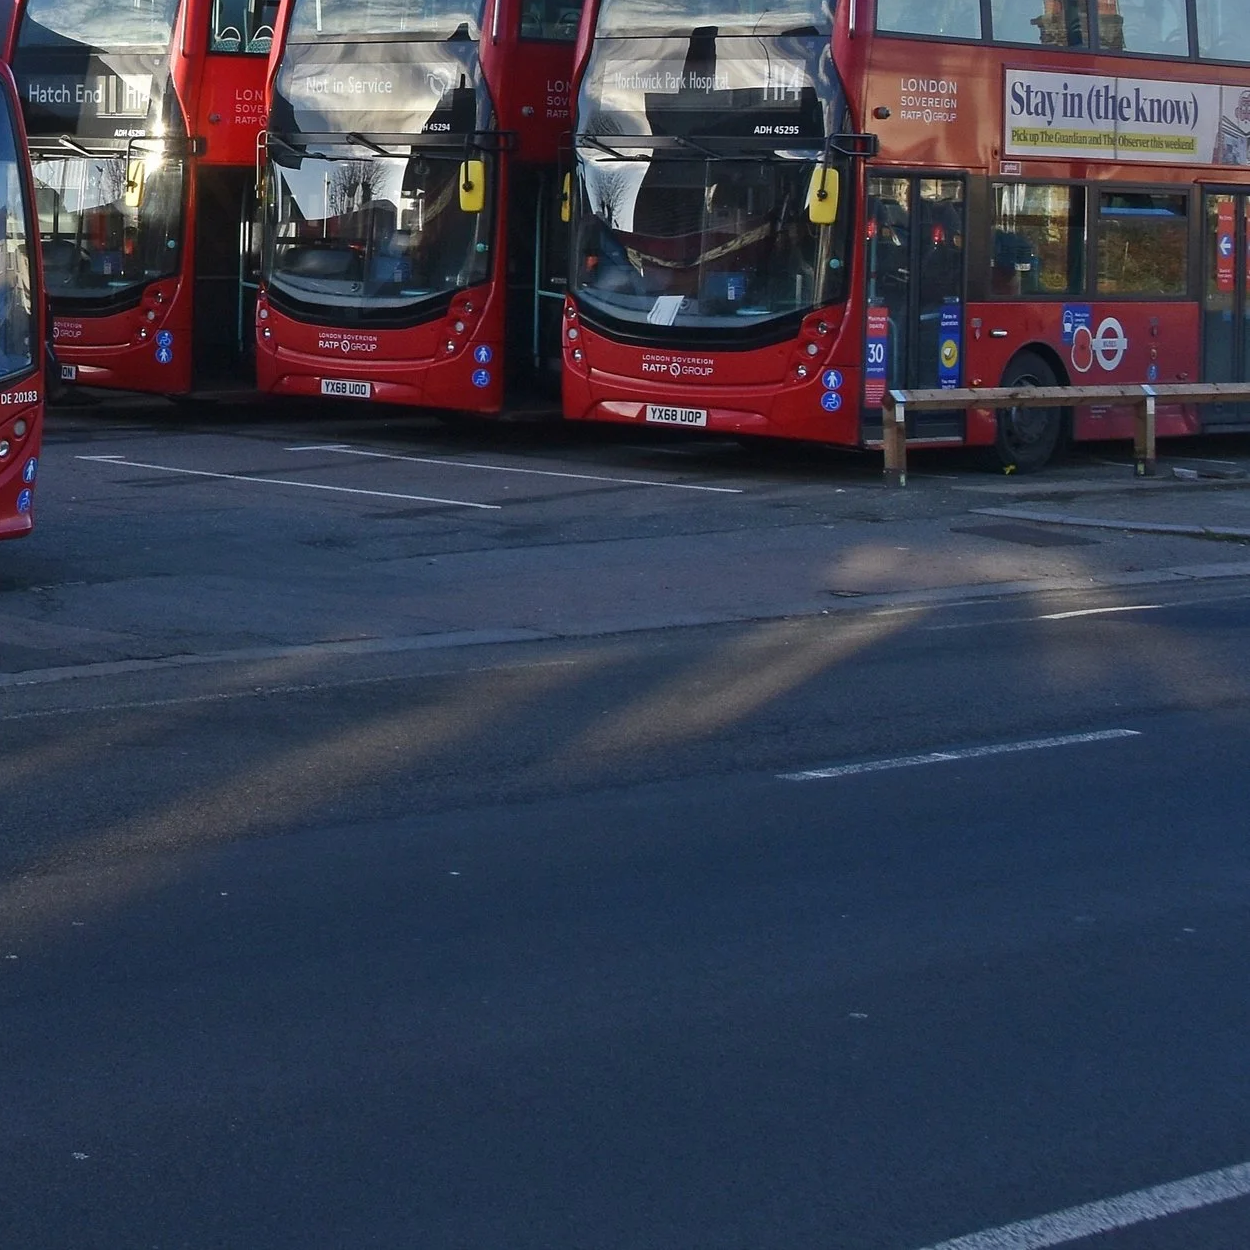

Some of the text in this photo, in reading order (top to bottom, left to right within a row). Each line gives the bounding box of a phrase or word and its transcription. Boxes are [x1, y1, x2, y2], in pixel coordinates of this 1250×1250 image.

[306, 76, 392, 94] Not in Service
[615, 71, 729, 94] Northwick Park Hospital
[763, 64, 802, 101] H14
[901, 78, 957, 94] LONDON
[29, 83, 102, 103] Hatch End
[235, 89, 264, 101] LON
[901, 96, 957, 108] SOVEREIGN
[1010, 81, 1198, 130] Stay in (the know)
[234, 116, 258, 124] RATP
[546, 109, 569, 119] RATP
[900, 110, 957, 122] RATP GROUP
[429, 123, 451, 132] 45294
[754, 126, 800, 135] ADH 45295
[1011, 130, 1195, 150] Pick up The Guardian and The Observer this weekend
[318, 340, 378, 352] RATP GROUP
[642, 354, 714, 365] LONDON SOVEREIGN
[867, 343, 884, 363] 30
[62, 366, 73, 378] ON
[642, 363, 714, 376] RATP GROUP
[325, 381, 347, 394] YX68
[0, 390, 38, 405] DE 20183
[651, 407, 702, 423] YX68 UOP
